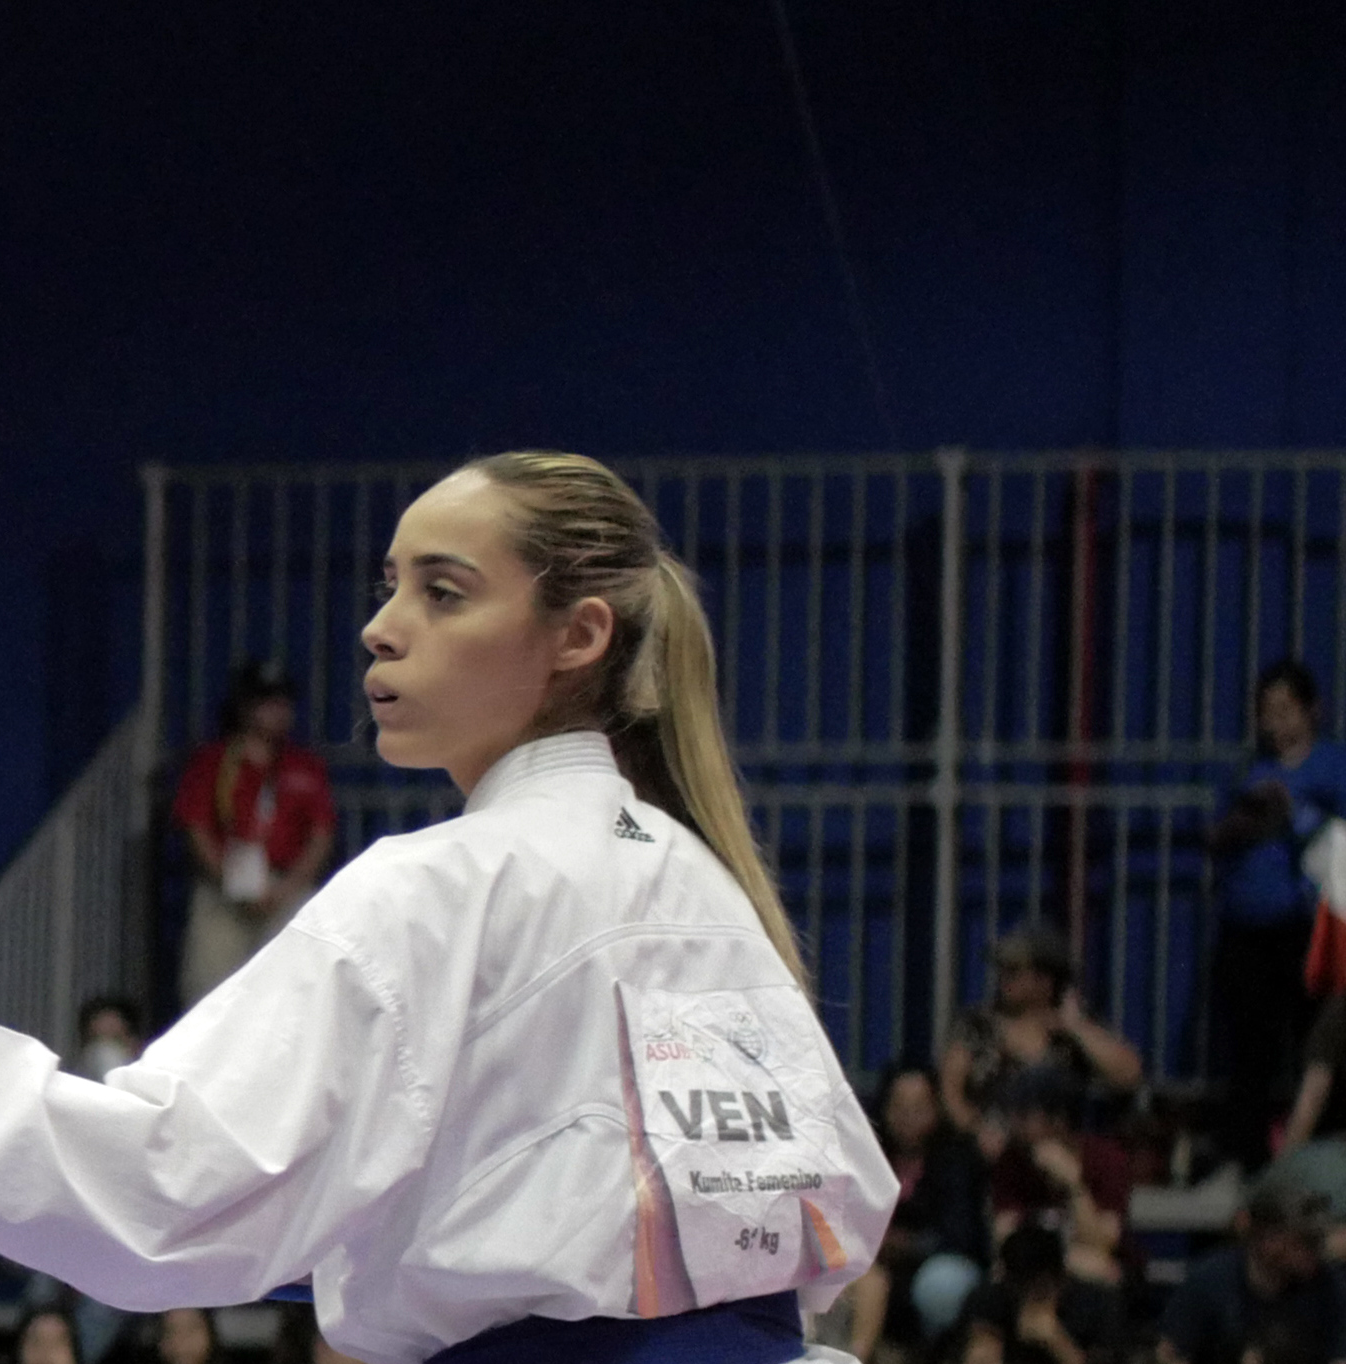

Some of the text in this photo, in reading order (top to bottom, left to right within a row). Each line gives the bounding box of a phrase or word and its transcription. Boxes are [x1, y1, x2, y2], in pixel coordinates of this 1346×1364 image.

[657, 1088, 796, 1142] VEN
[689, 1170, 743, 1194] Kumite
[760, 1226, 780, 1255] kg
